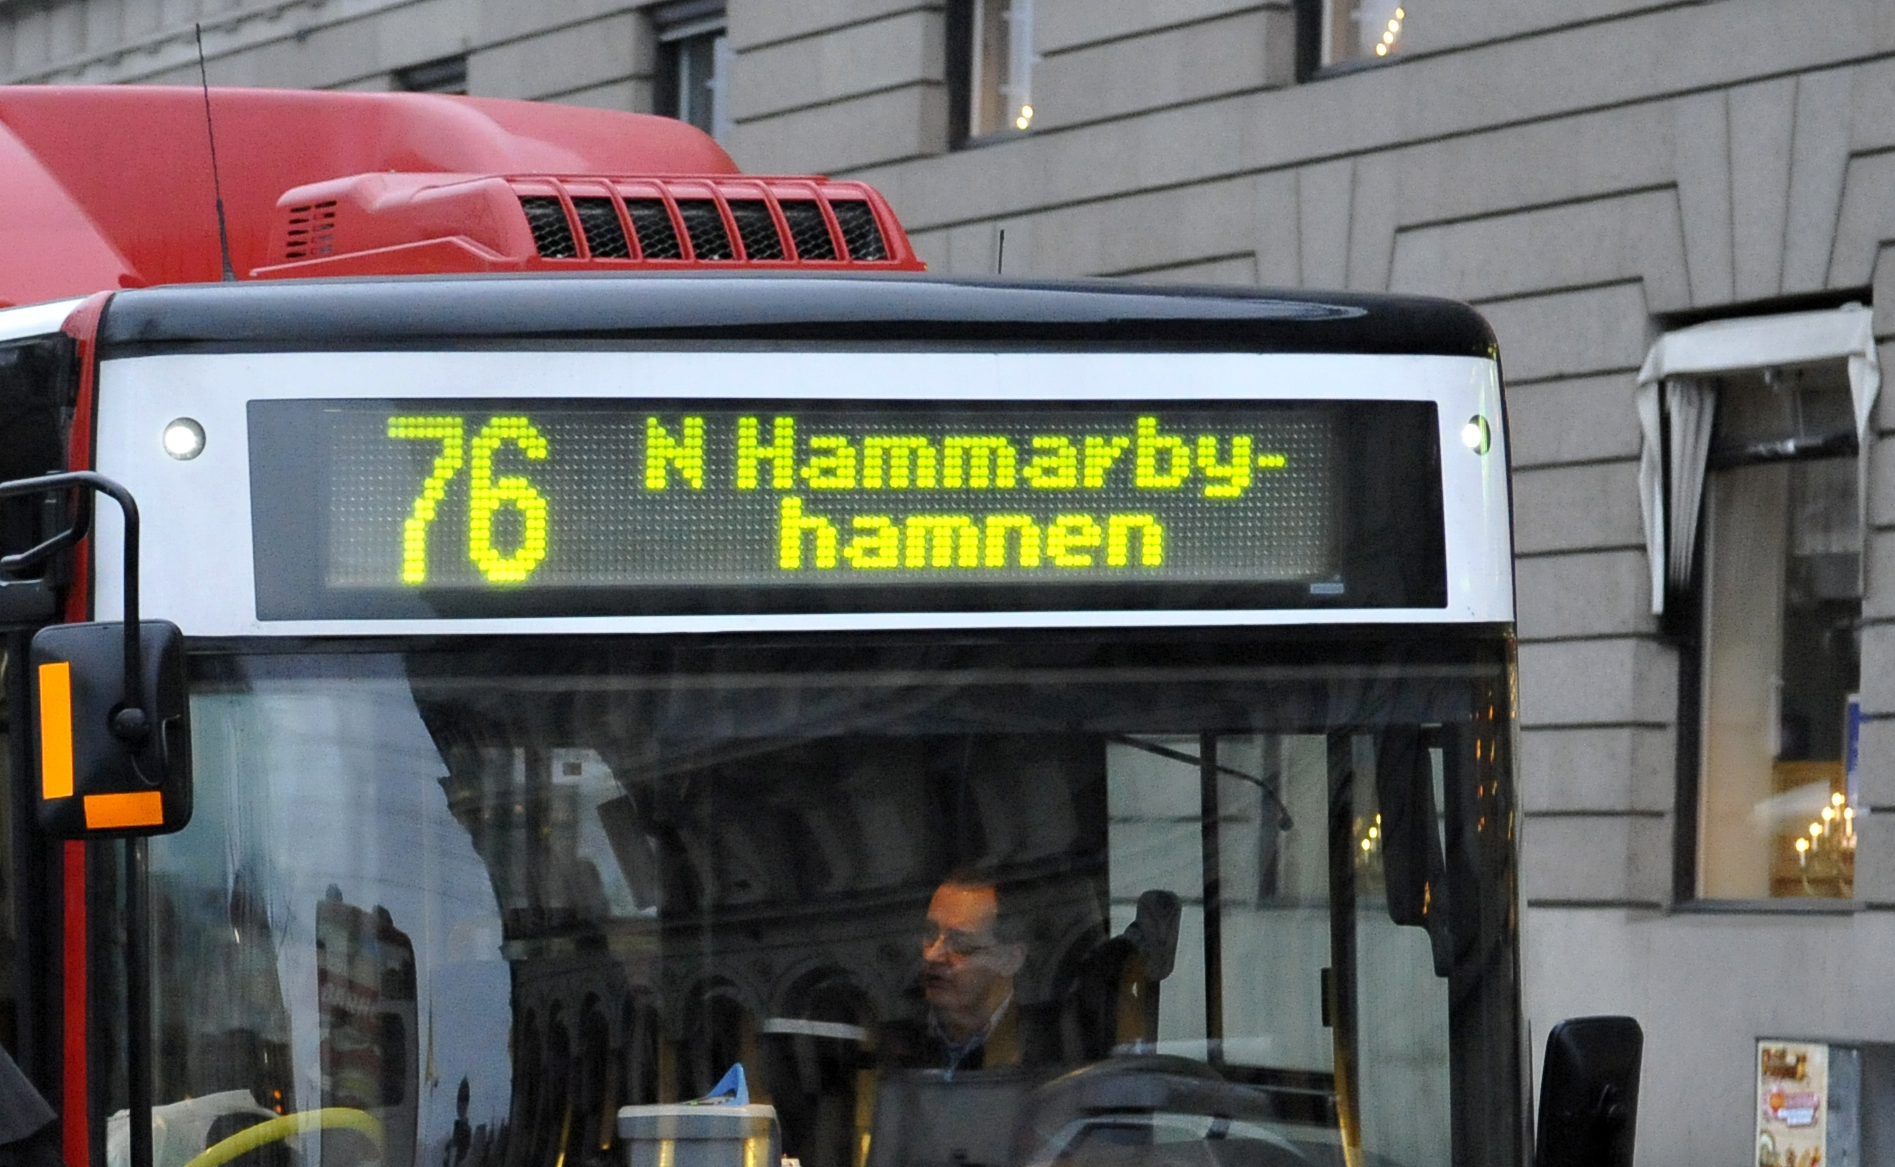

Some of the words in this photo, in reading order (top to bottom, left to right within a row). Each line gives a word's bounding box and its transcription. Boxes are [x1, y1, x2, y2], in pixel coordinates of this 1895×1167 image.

[389, 415, 549, 586] 76
[645, 417, 705, 490] N
[736, 417, 1286, 499] Hammarby-
[778, 498, 1165, 571] hamnen
